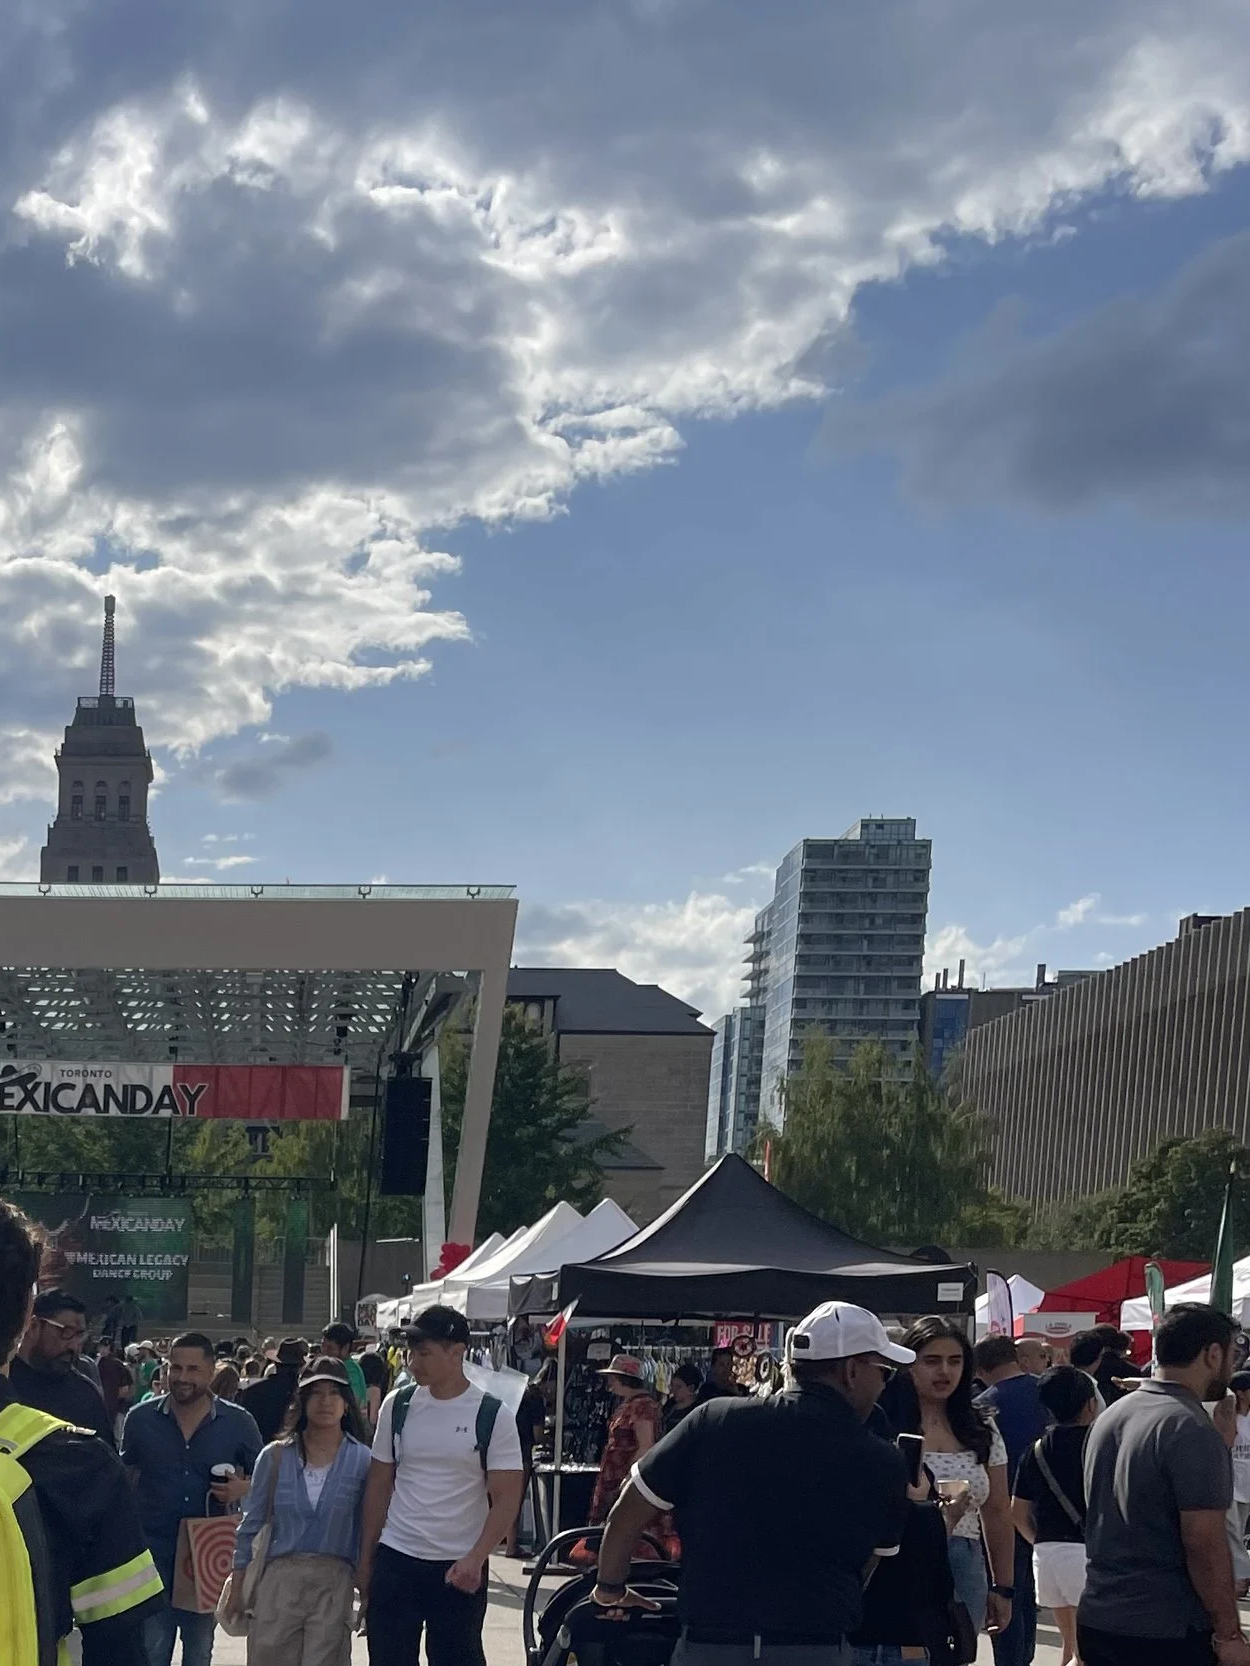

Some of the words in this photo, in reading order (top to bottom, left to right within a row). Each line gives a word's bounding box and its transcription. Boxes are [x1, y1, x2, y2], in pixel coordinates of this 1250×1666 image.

[59, 1068, 113, 1079] TORONTO
[139, 1254, 189, 1266] LEGACY
[133, 1269, 174, 1280] GROUP
